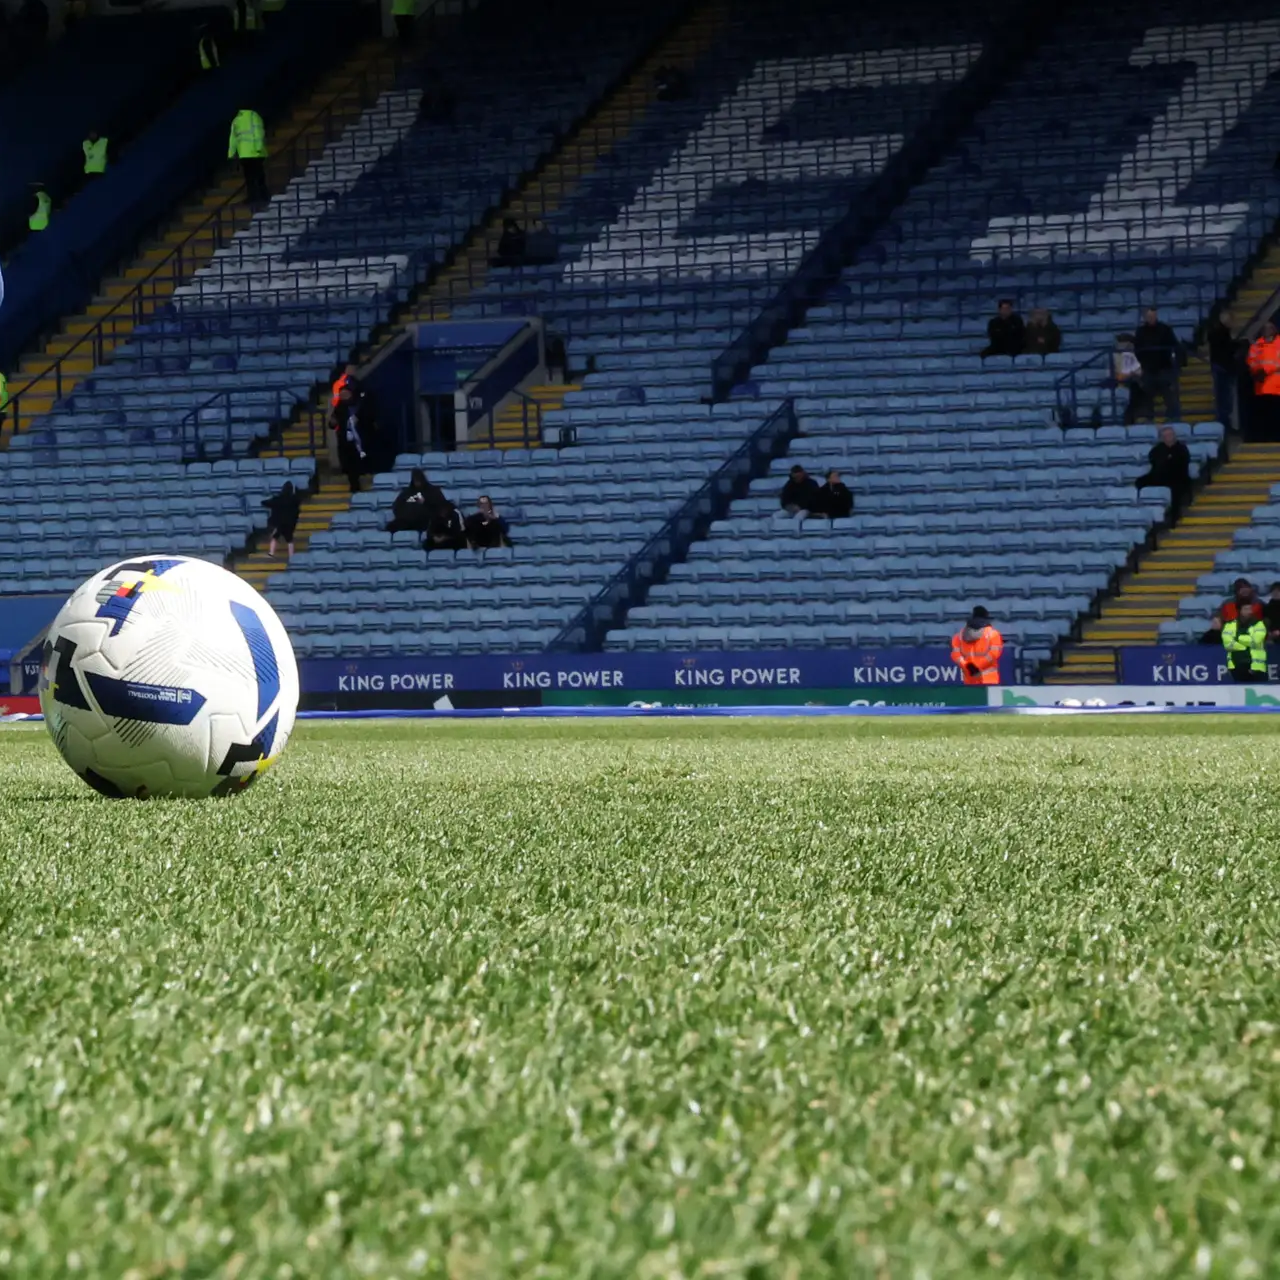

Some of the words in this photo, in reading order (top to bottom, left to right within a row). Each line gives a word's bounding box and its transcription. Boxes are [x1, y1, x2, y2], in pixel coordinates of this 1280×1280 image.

[339, 675, 384, 691] KING
[390, 673, 454, 689] POWER
[503, 672, 551, 688] KING
[557, 671, 623, 687] POWER
[675, 669, 724, 685] KING
[731, 668, 800, 685] POWER
[854, 666, 906, 683] KING
[913, 665, 964, 682] POW
[1152, 665, 1209, 682] KING
